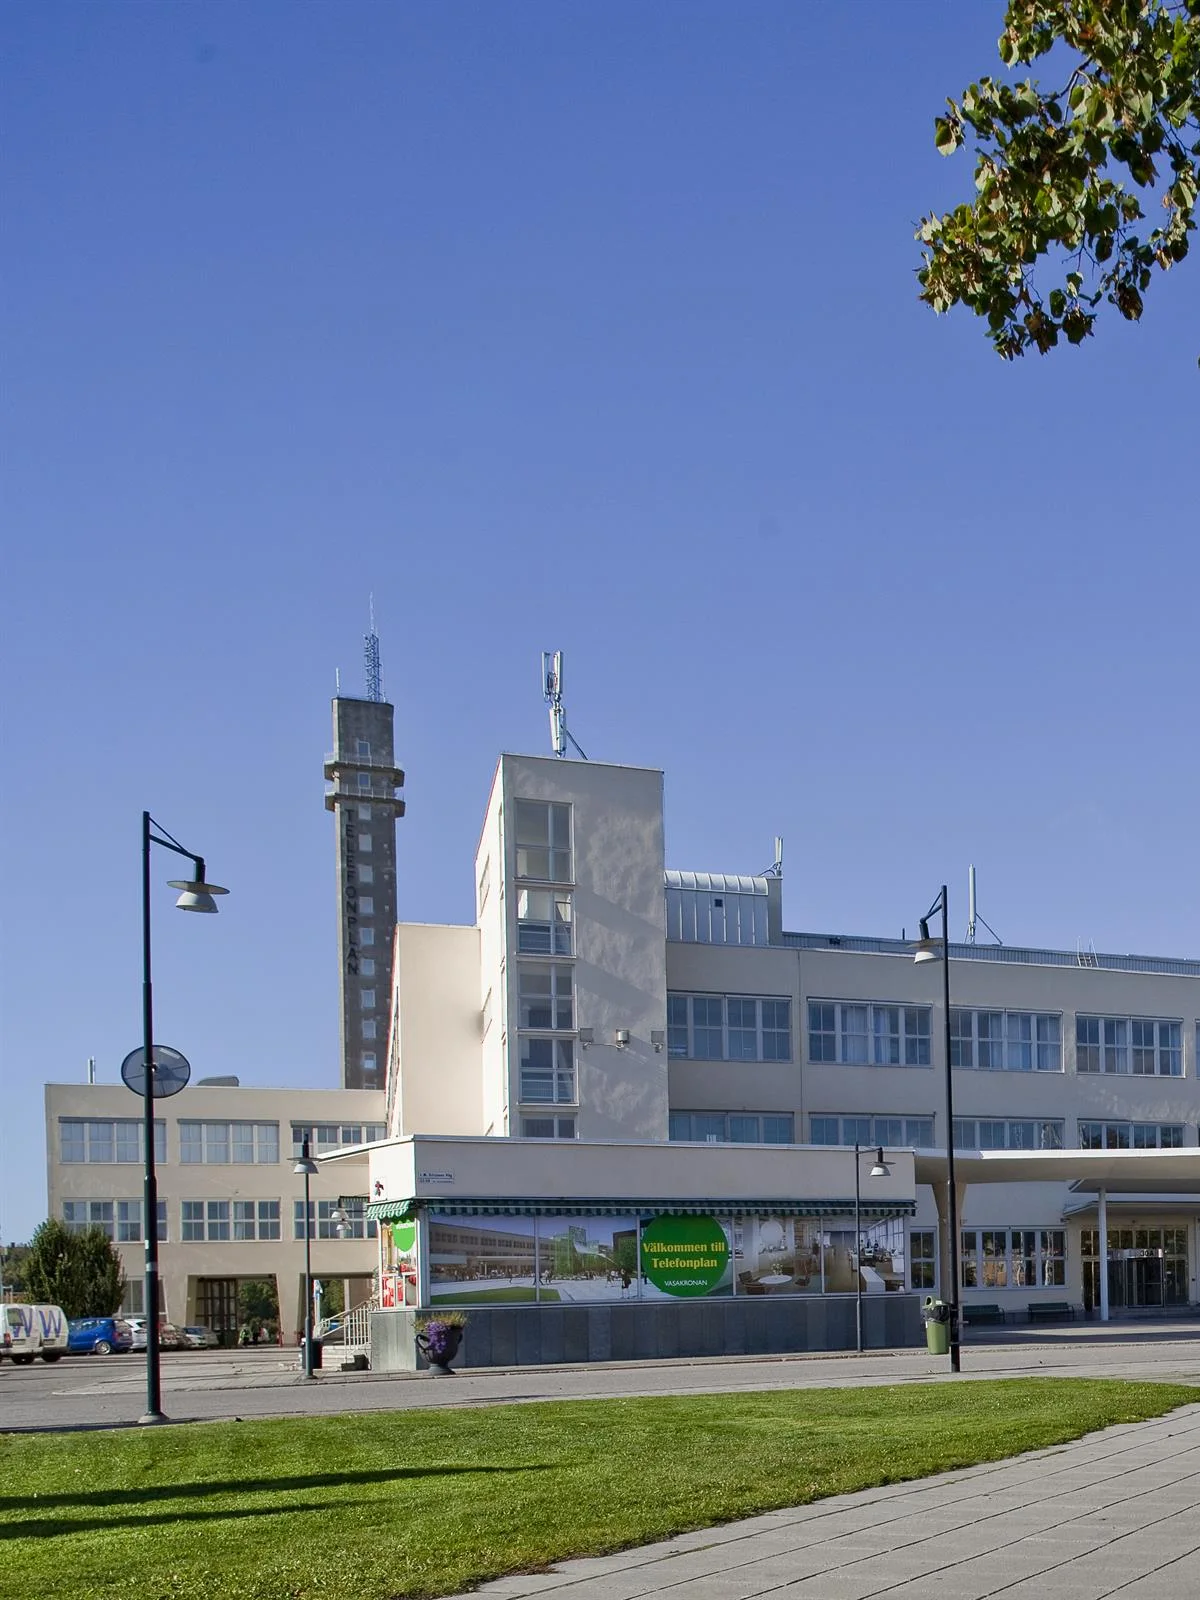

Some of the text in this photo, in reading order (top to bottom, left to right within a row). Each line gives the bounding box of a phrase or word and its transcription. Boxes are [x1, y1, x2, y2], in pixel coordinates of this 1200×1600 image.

[344, 808, 358, 976] TELEFONPLAN
[643, 1242, 725, 1253] Välkommen till
[652, 1258, 717, 1269] Telefonplan
